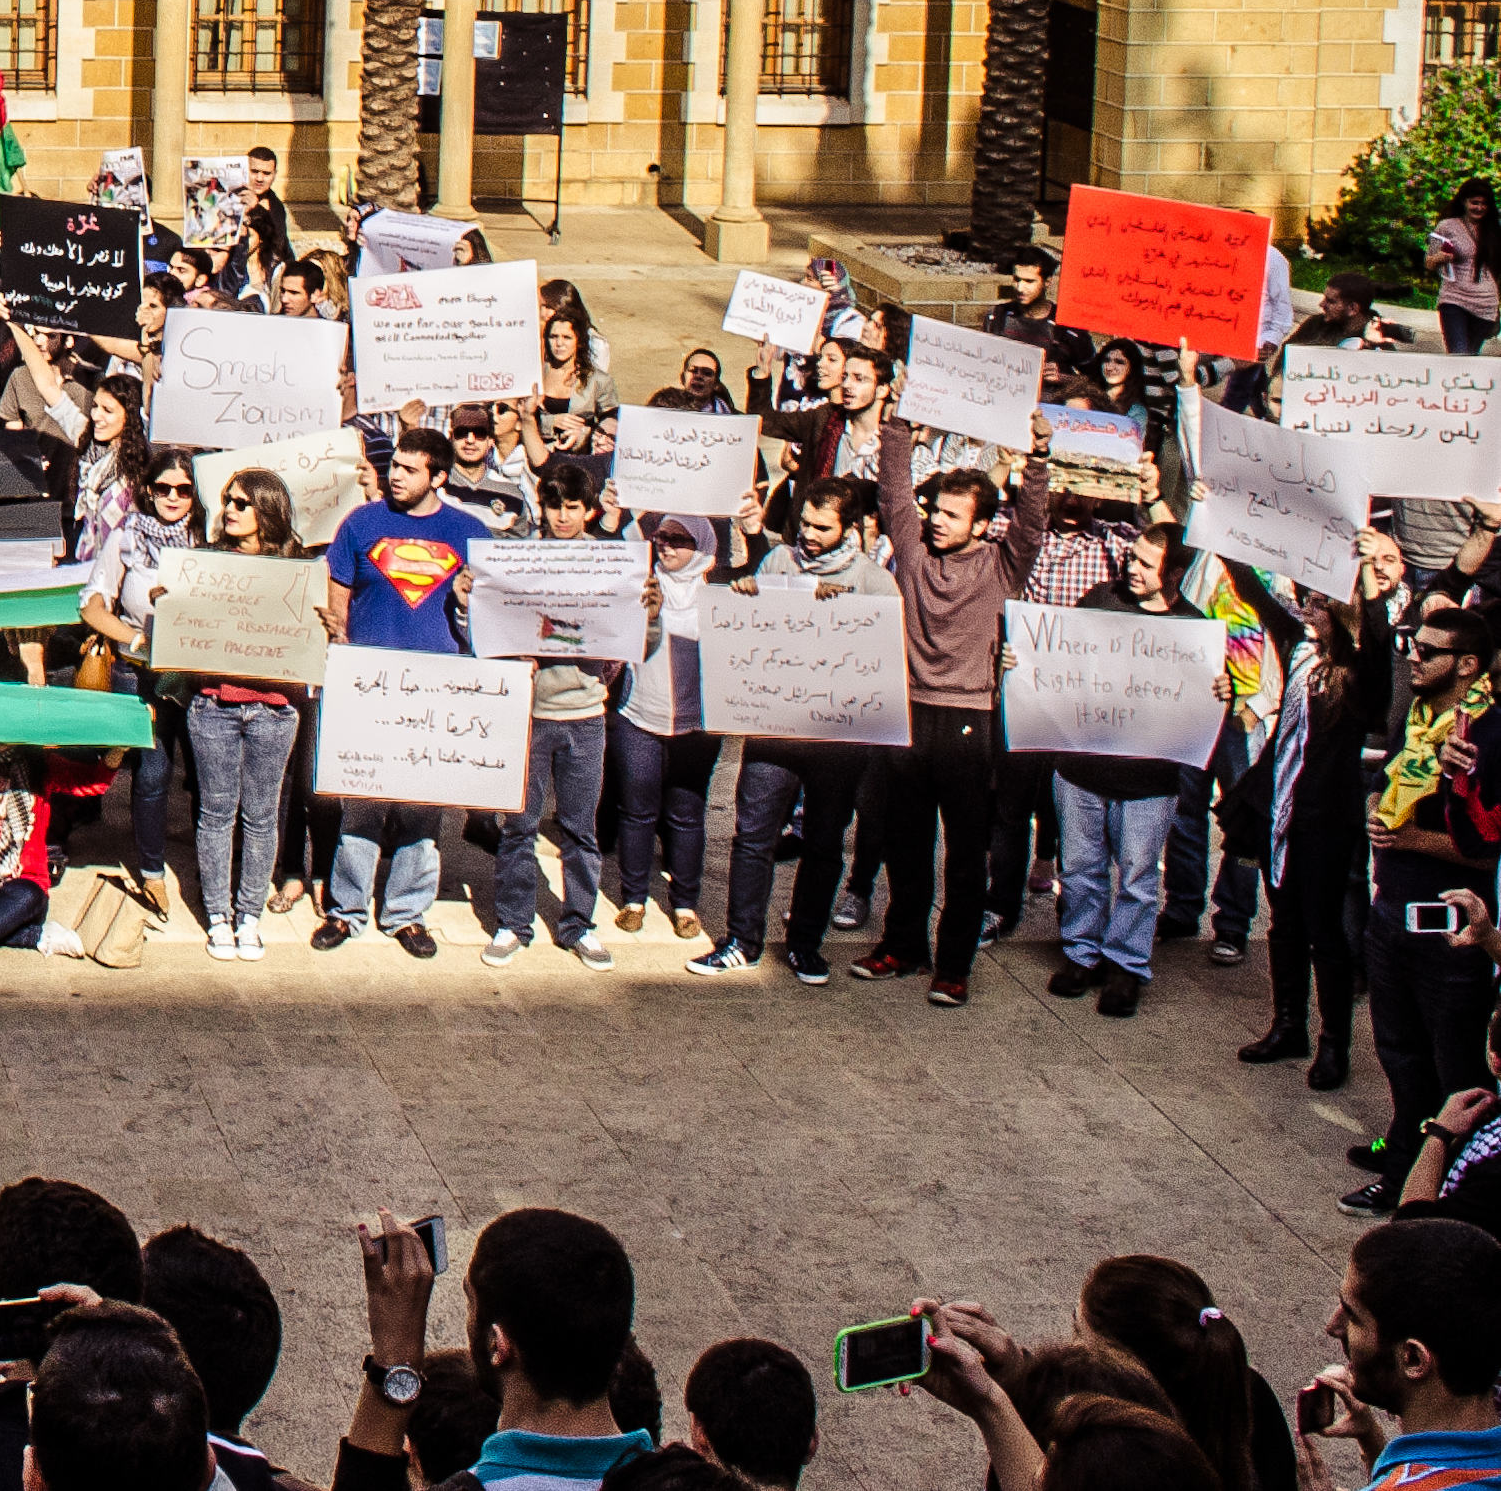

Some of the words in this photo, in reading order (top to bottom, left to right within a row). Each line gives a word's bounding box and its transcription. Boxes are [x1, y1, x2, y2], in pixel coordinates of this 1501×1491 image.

[111, 249, 125, 267] لا
[394, 321, 413, 329] are
[442, 320, 464, 328] our
[505, 319, 527, 327] are
[180, 327, 295, 390] Smash
[1286, 363, 1340, 382] فلسطين
[211, 391, 323, 426] Zionism
[1365, 416, 1428, 439] روحك
[1439, 421, 1480, 444] يلعن
[1227, 527, 1252, 546] AUB
[178, 558, 262, 592] RESPECT
[189, 586, 265, 606] EXISTENCE
[172, 611, 226, 629] EXPECT
[228, 606, 253, 618] OR
[1022, 611, 1098, 655] Where
[179, 636, 217, 650] FREE
[224, 640, 292, 659] PALESTINE
[1033, 666, 1085, 693] Right
[1092, 673, 1113, 693] to
[1124, 674, 1184, 702] defend
